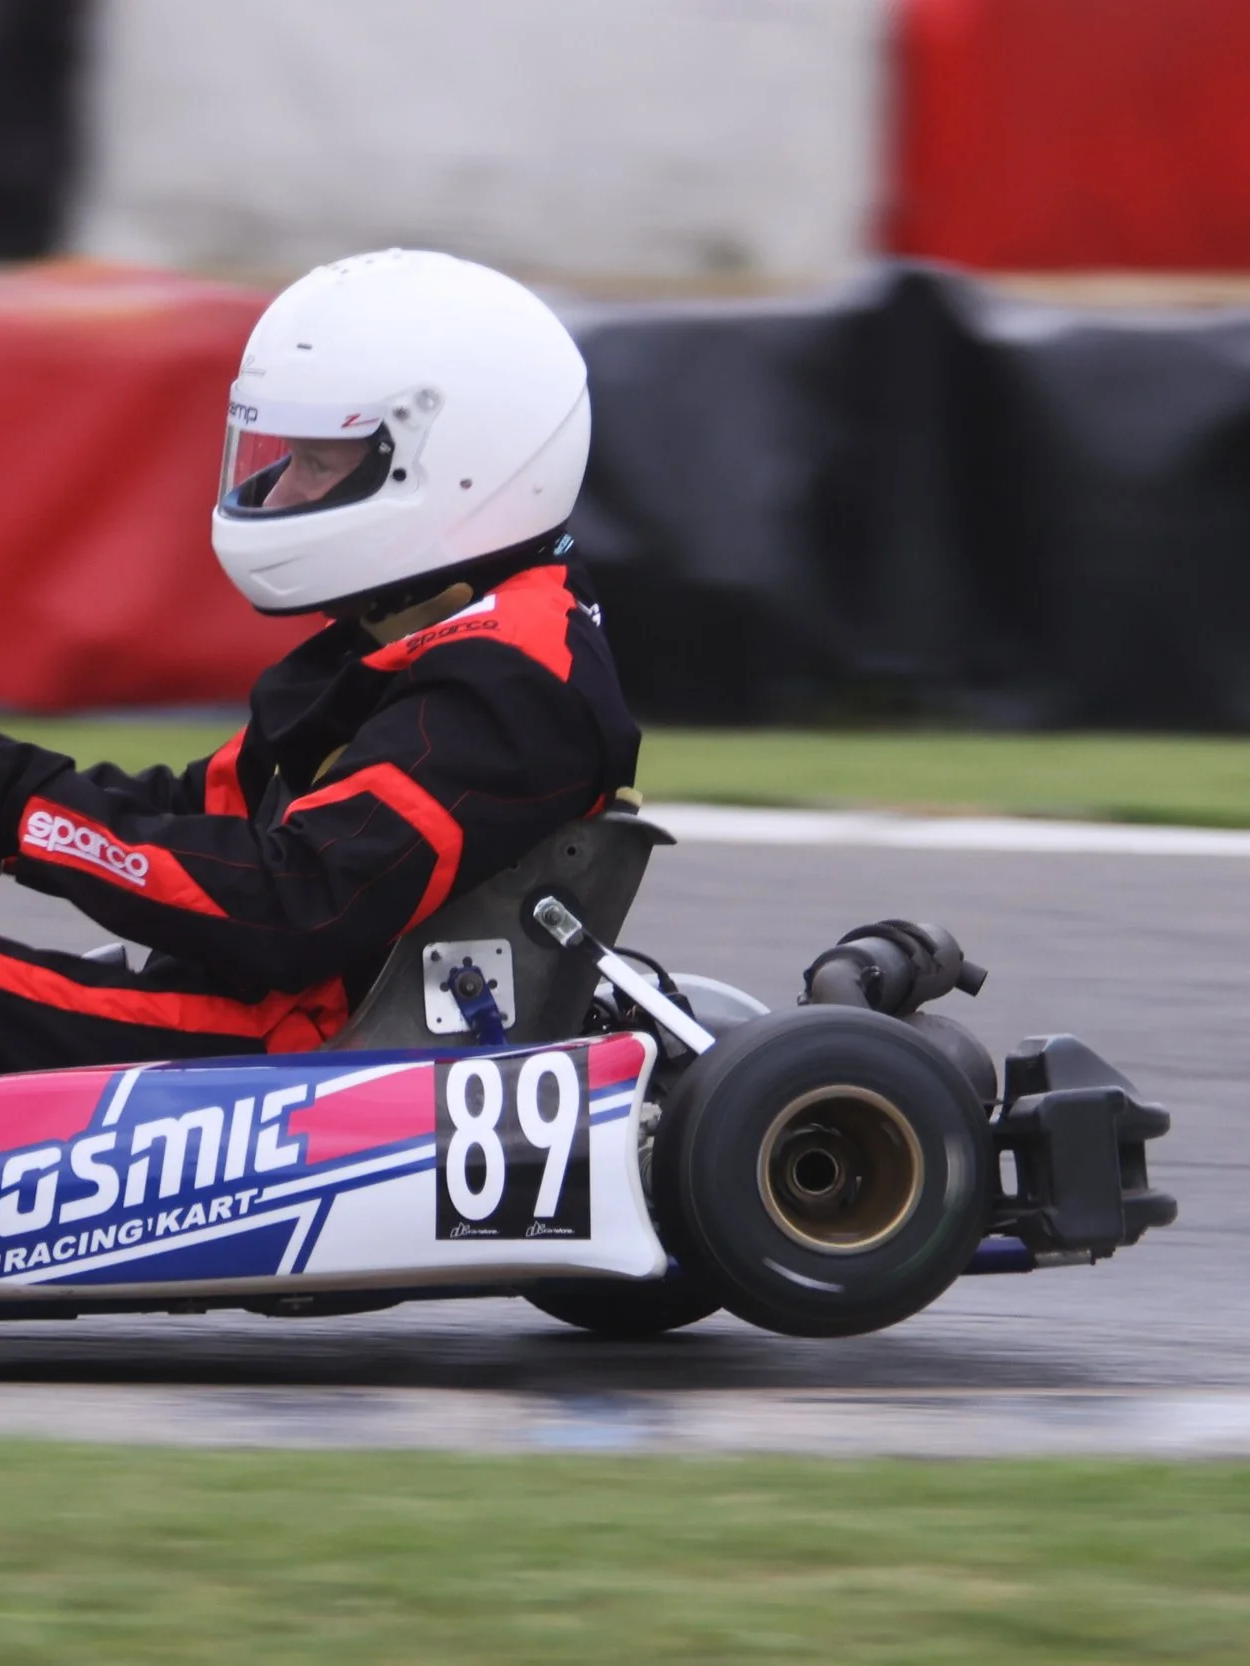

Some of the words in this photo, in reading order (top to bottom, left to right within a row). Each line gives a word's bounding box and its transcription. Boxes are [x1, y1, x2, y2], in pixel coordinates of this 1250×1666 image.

[406, 619, 499, 654] sparco
[24, 810, 149, 886] sparco
[446, 1051, 580, 1221] 89
[155, 1188, 259, 1236] KART
